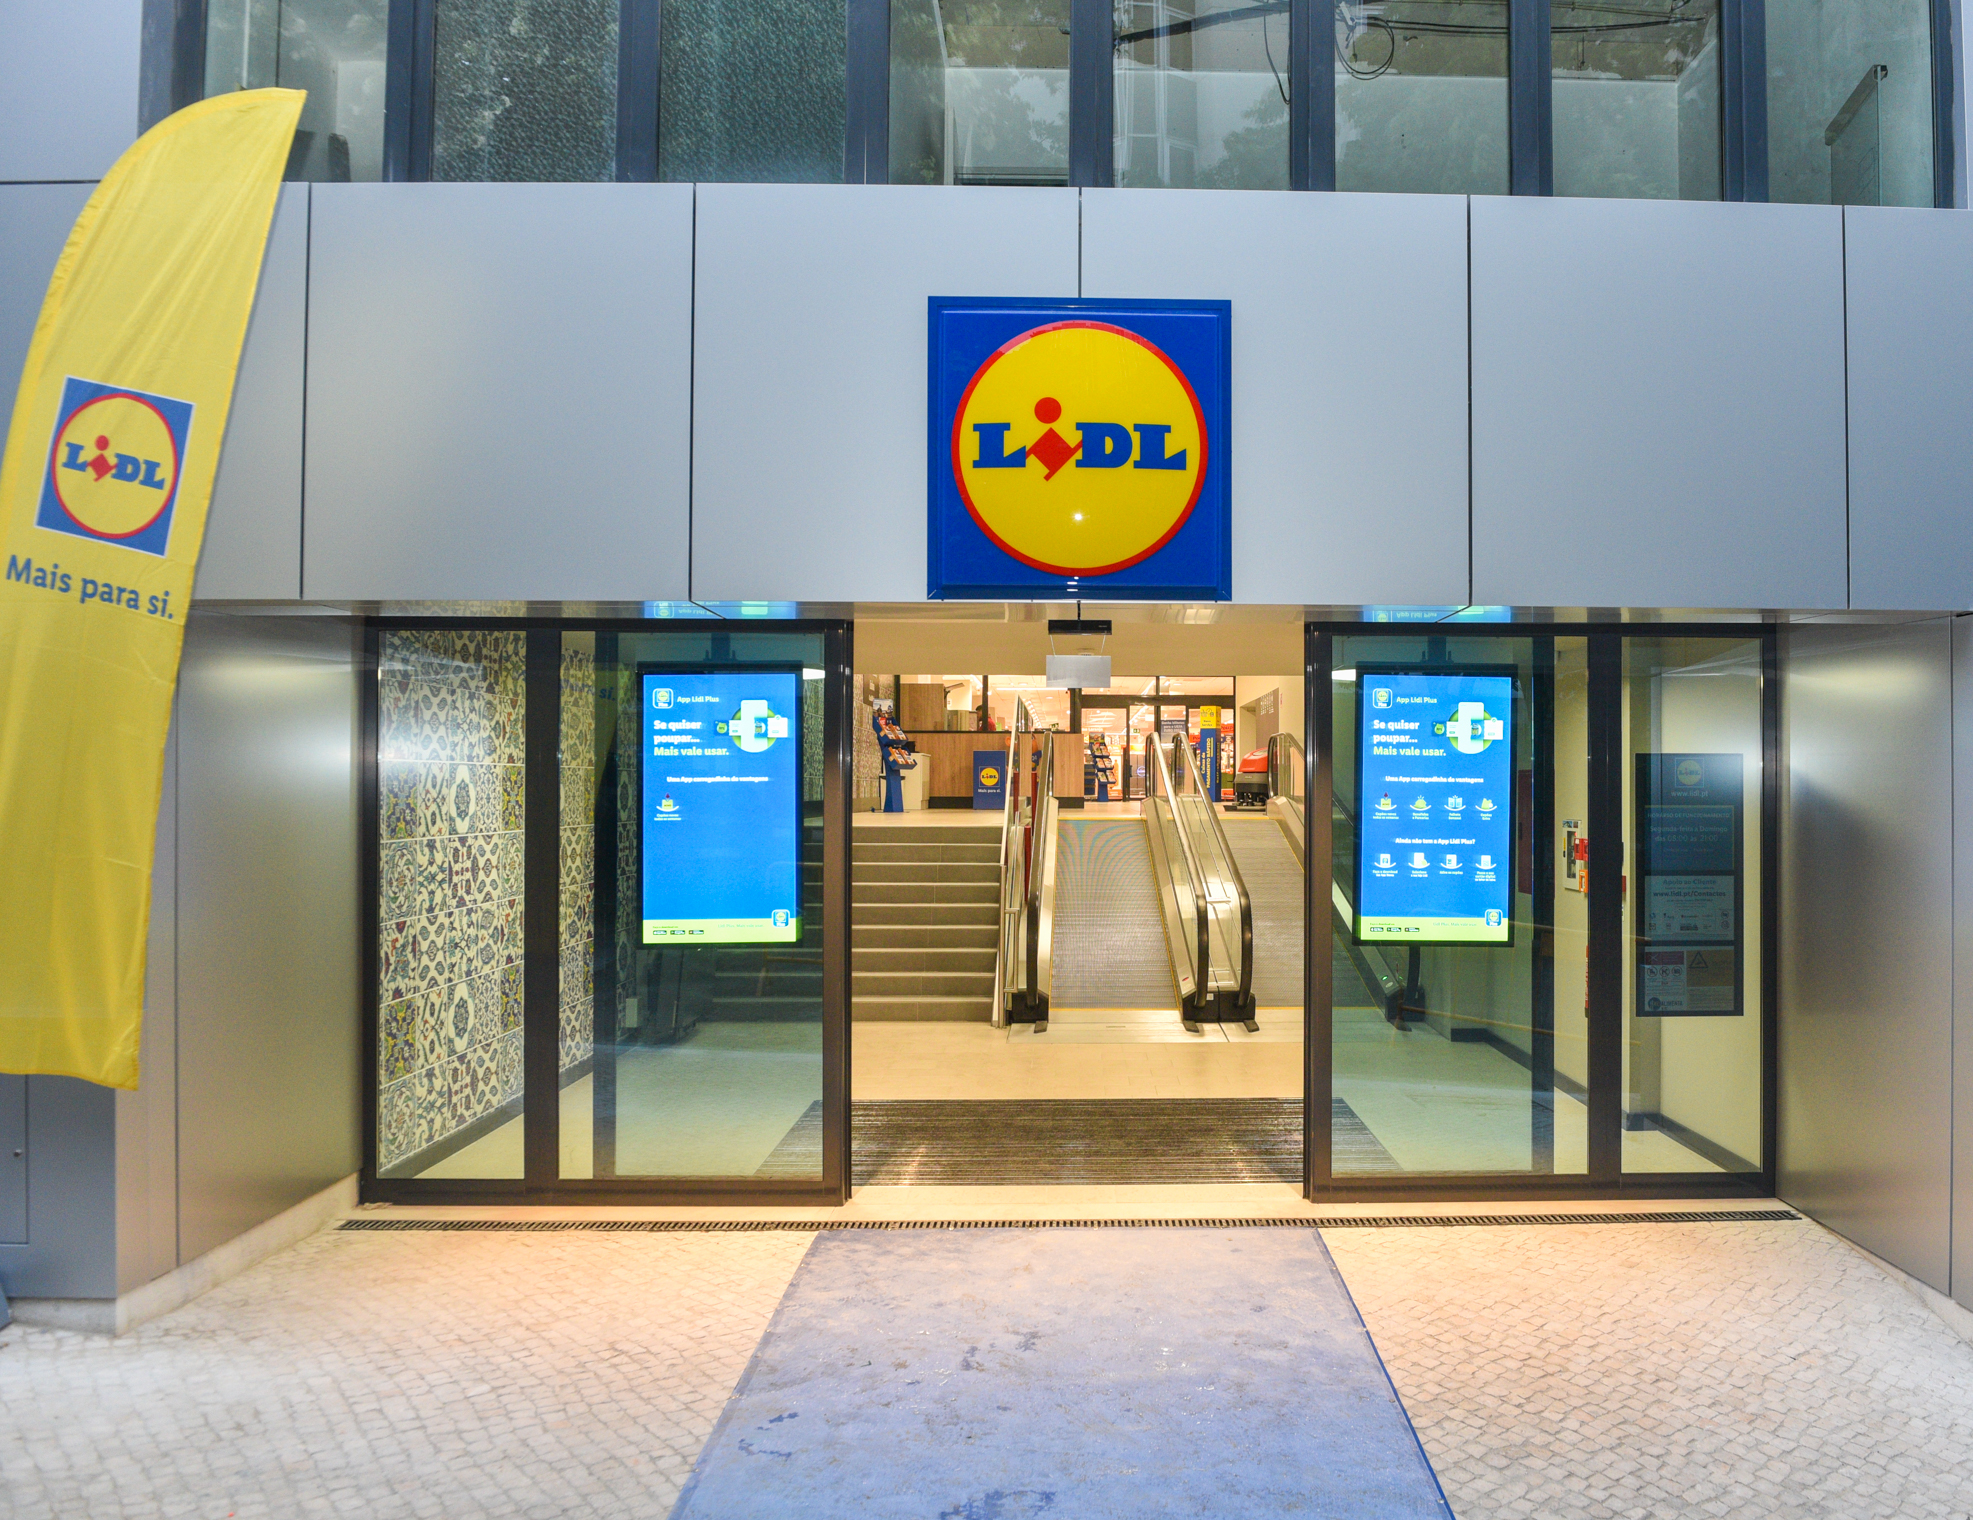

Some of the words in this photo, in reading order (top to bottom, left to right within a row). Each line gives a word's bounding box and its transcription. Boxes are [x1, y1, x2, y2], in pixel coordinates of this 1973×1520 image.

[6, 554, 72, 593] Mais
[80, 577, 140, 611] para
[147, 591, 174, 620] si.
[654, 720, 666, 729] Se
[668, 719, 702, 732] quiser
[1373, 720, 1385, 729] Se
[1388, 720, 1420, 731] quiser
[1373, 735, 1418, 744] poupar...
[654, 746, 679, 756] Mais
[681, 746, 702, 756] vale
[1373, 746, 1397, 755] Mais
[1399, 746, 1420, 756] vale
